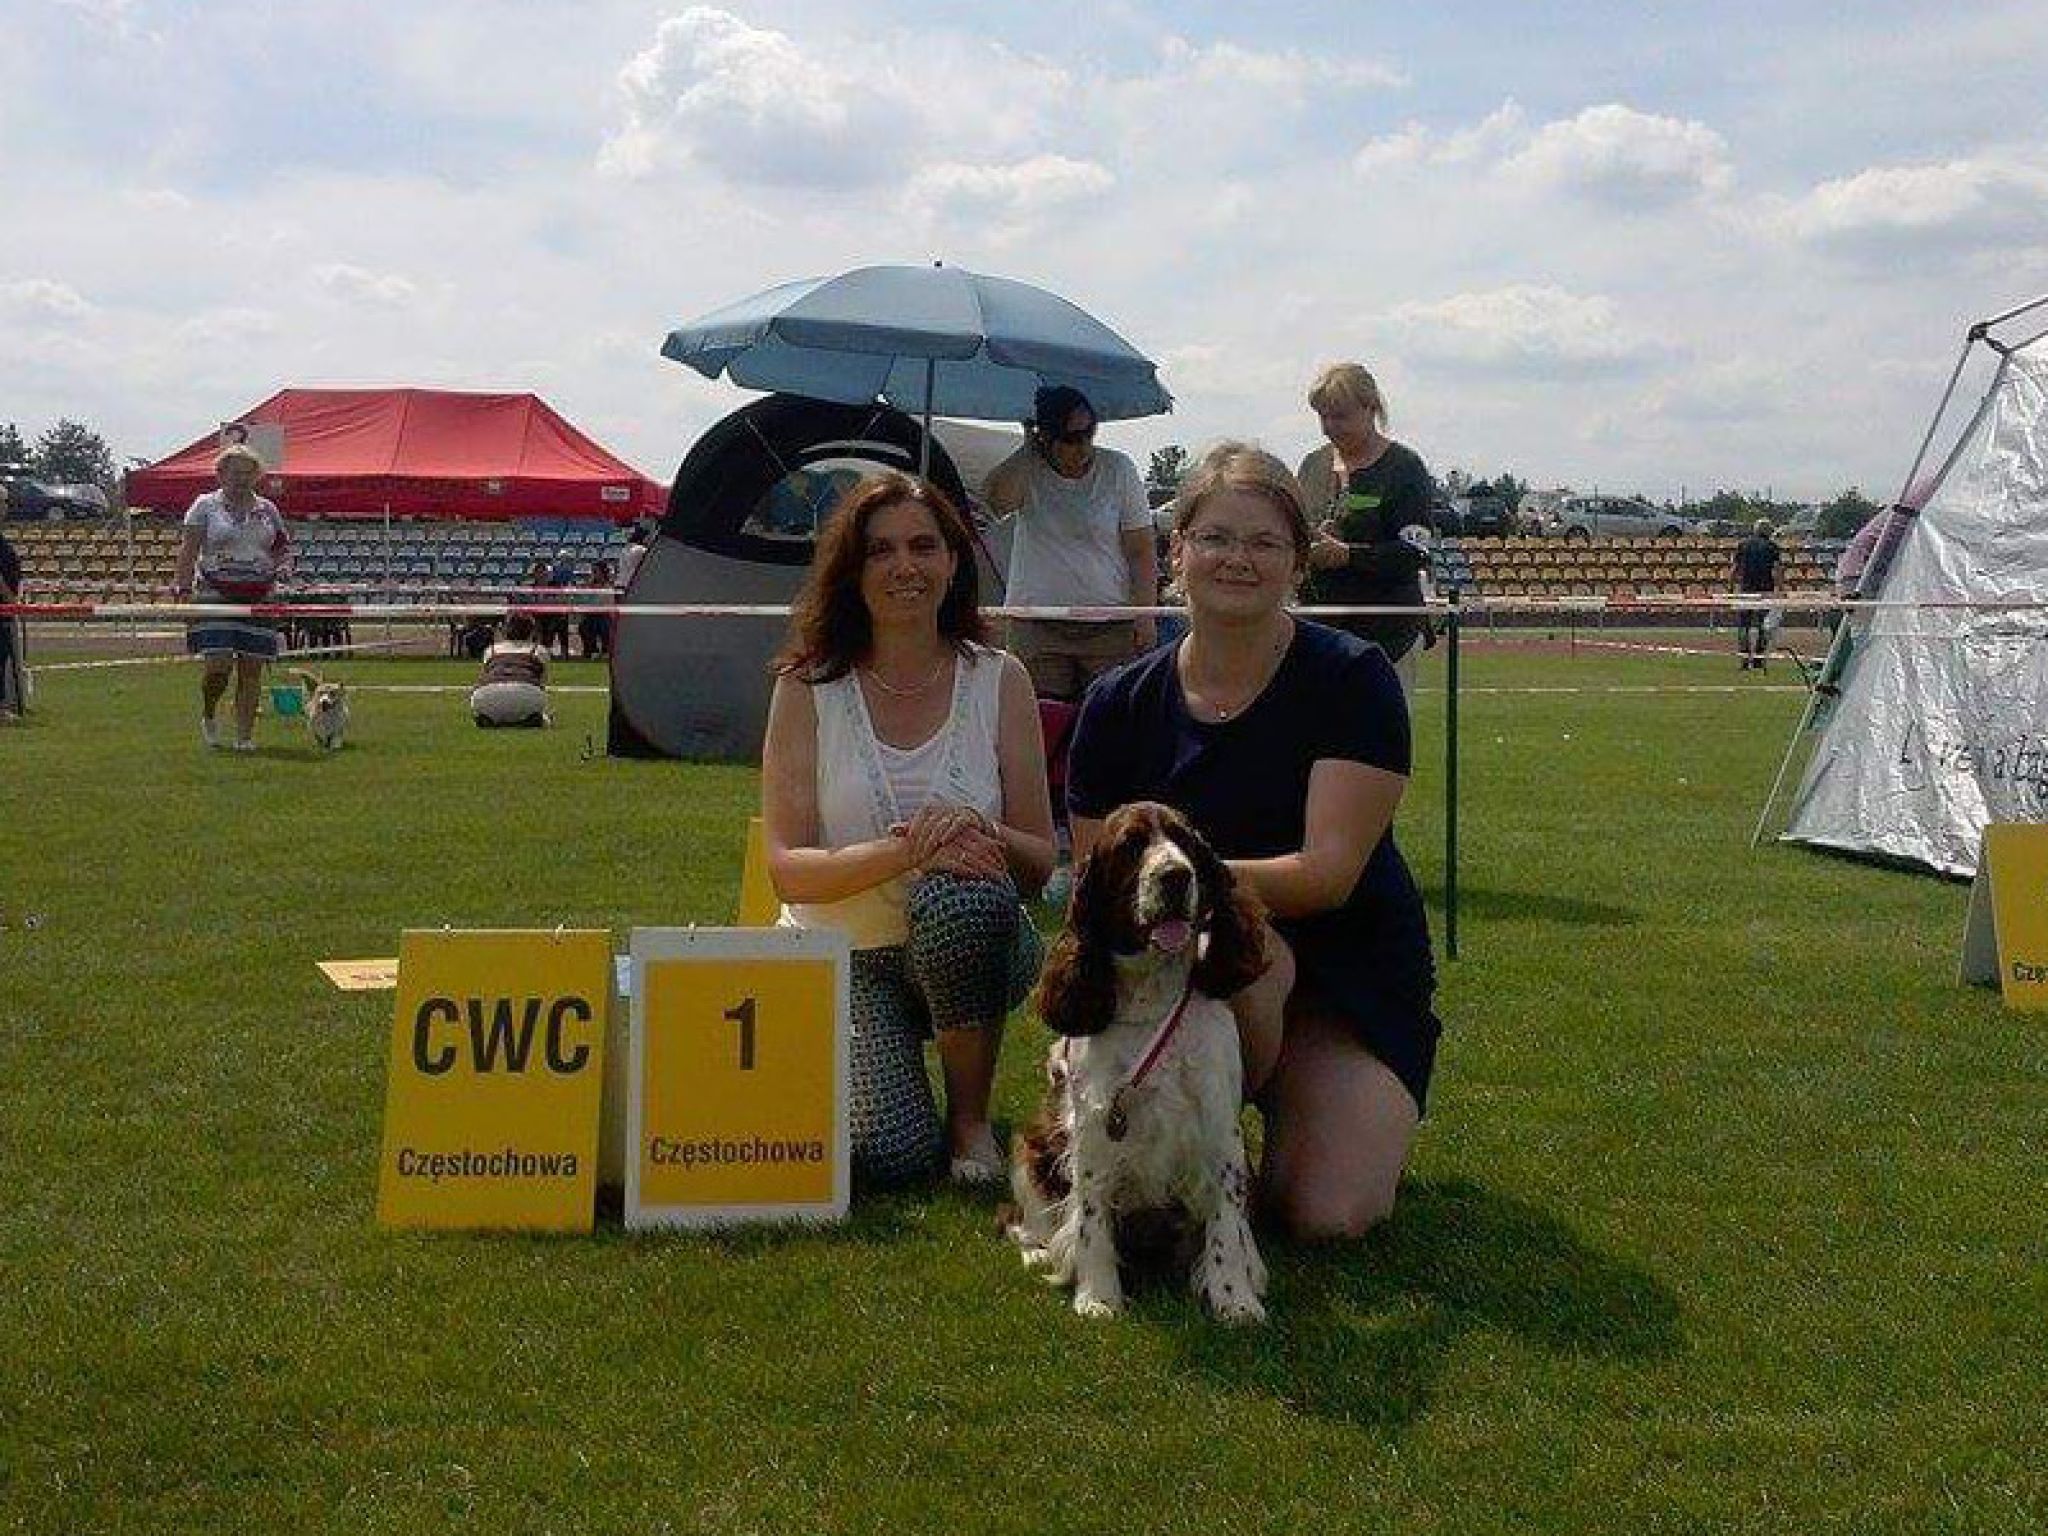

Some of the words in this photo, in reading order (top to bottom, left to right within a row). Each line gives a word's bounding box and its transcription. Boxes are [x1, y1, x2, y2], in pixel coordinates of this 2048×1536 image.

[2013, 962, 2048, 983] Czę
[414, 997, 592, 1076] CWC
[724, 998, 755, 1070] 1
[399, 1148, 577, 1183] Częstochowa
[653, 1136, 824, 1170] Częstochowa
